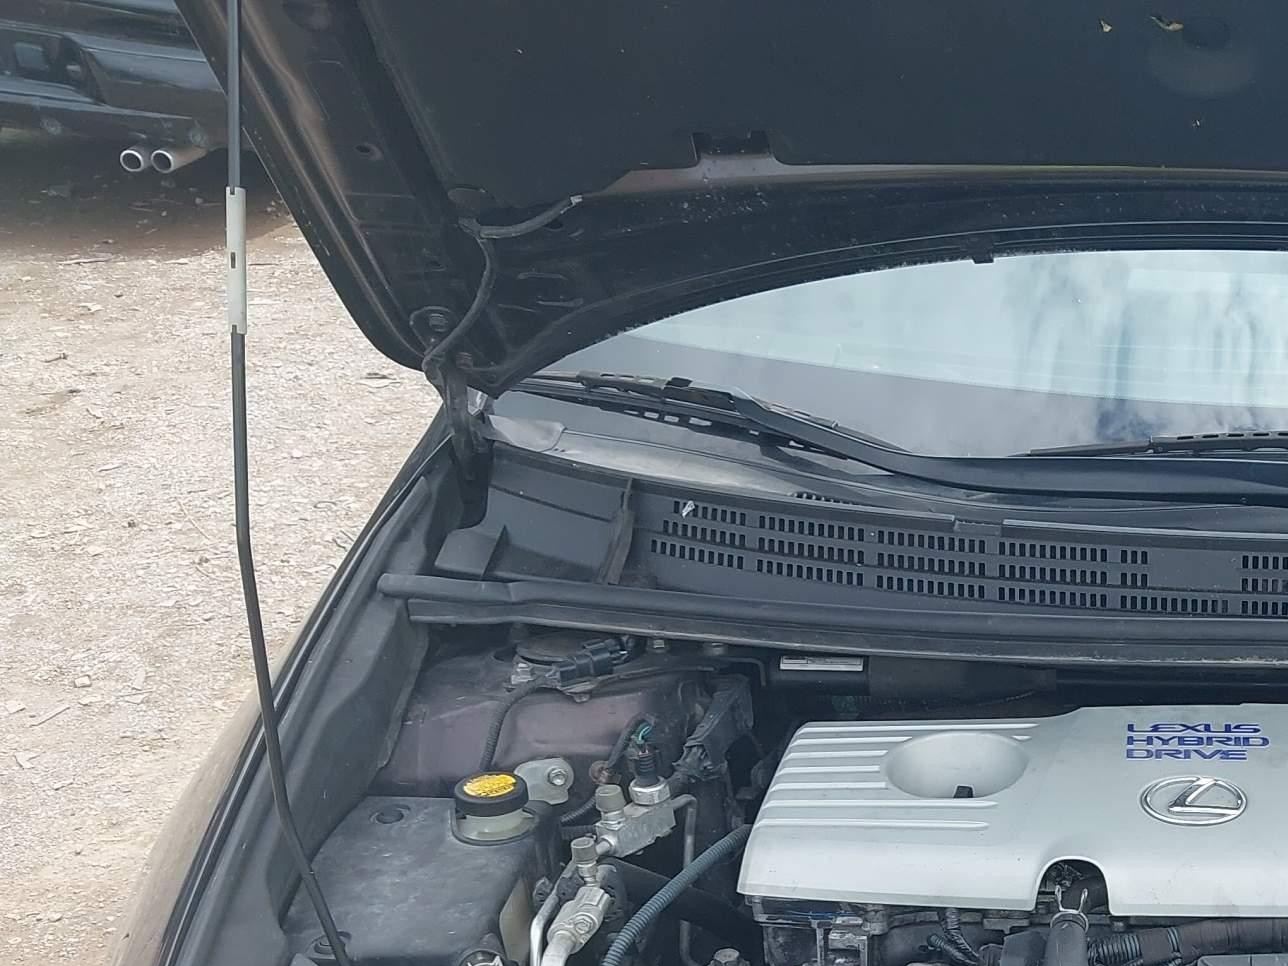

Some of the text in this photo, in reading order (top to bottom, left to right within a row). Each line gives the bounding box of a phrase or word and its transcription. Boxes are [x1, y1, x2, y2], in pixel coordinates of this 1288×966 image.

[1127, 723, 1261, 733] LEXUS
[1126, 735, 1270, 746] HYBRID
[1126, 748, 1248, 760] DRIVE
